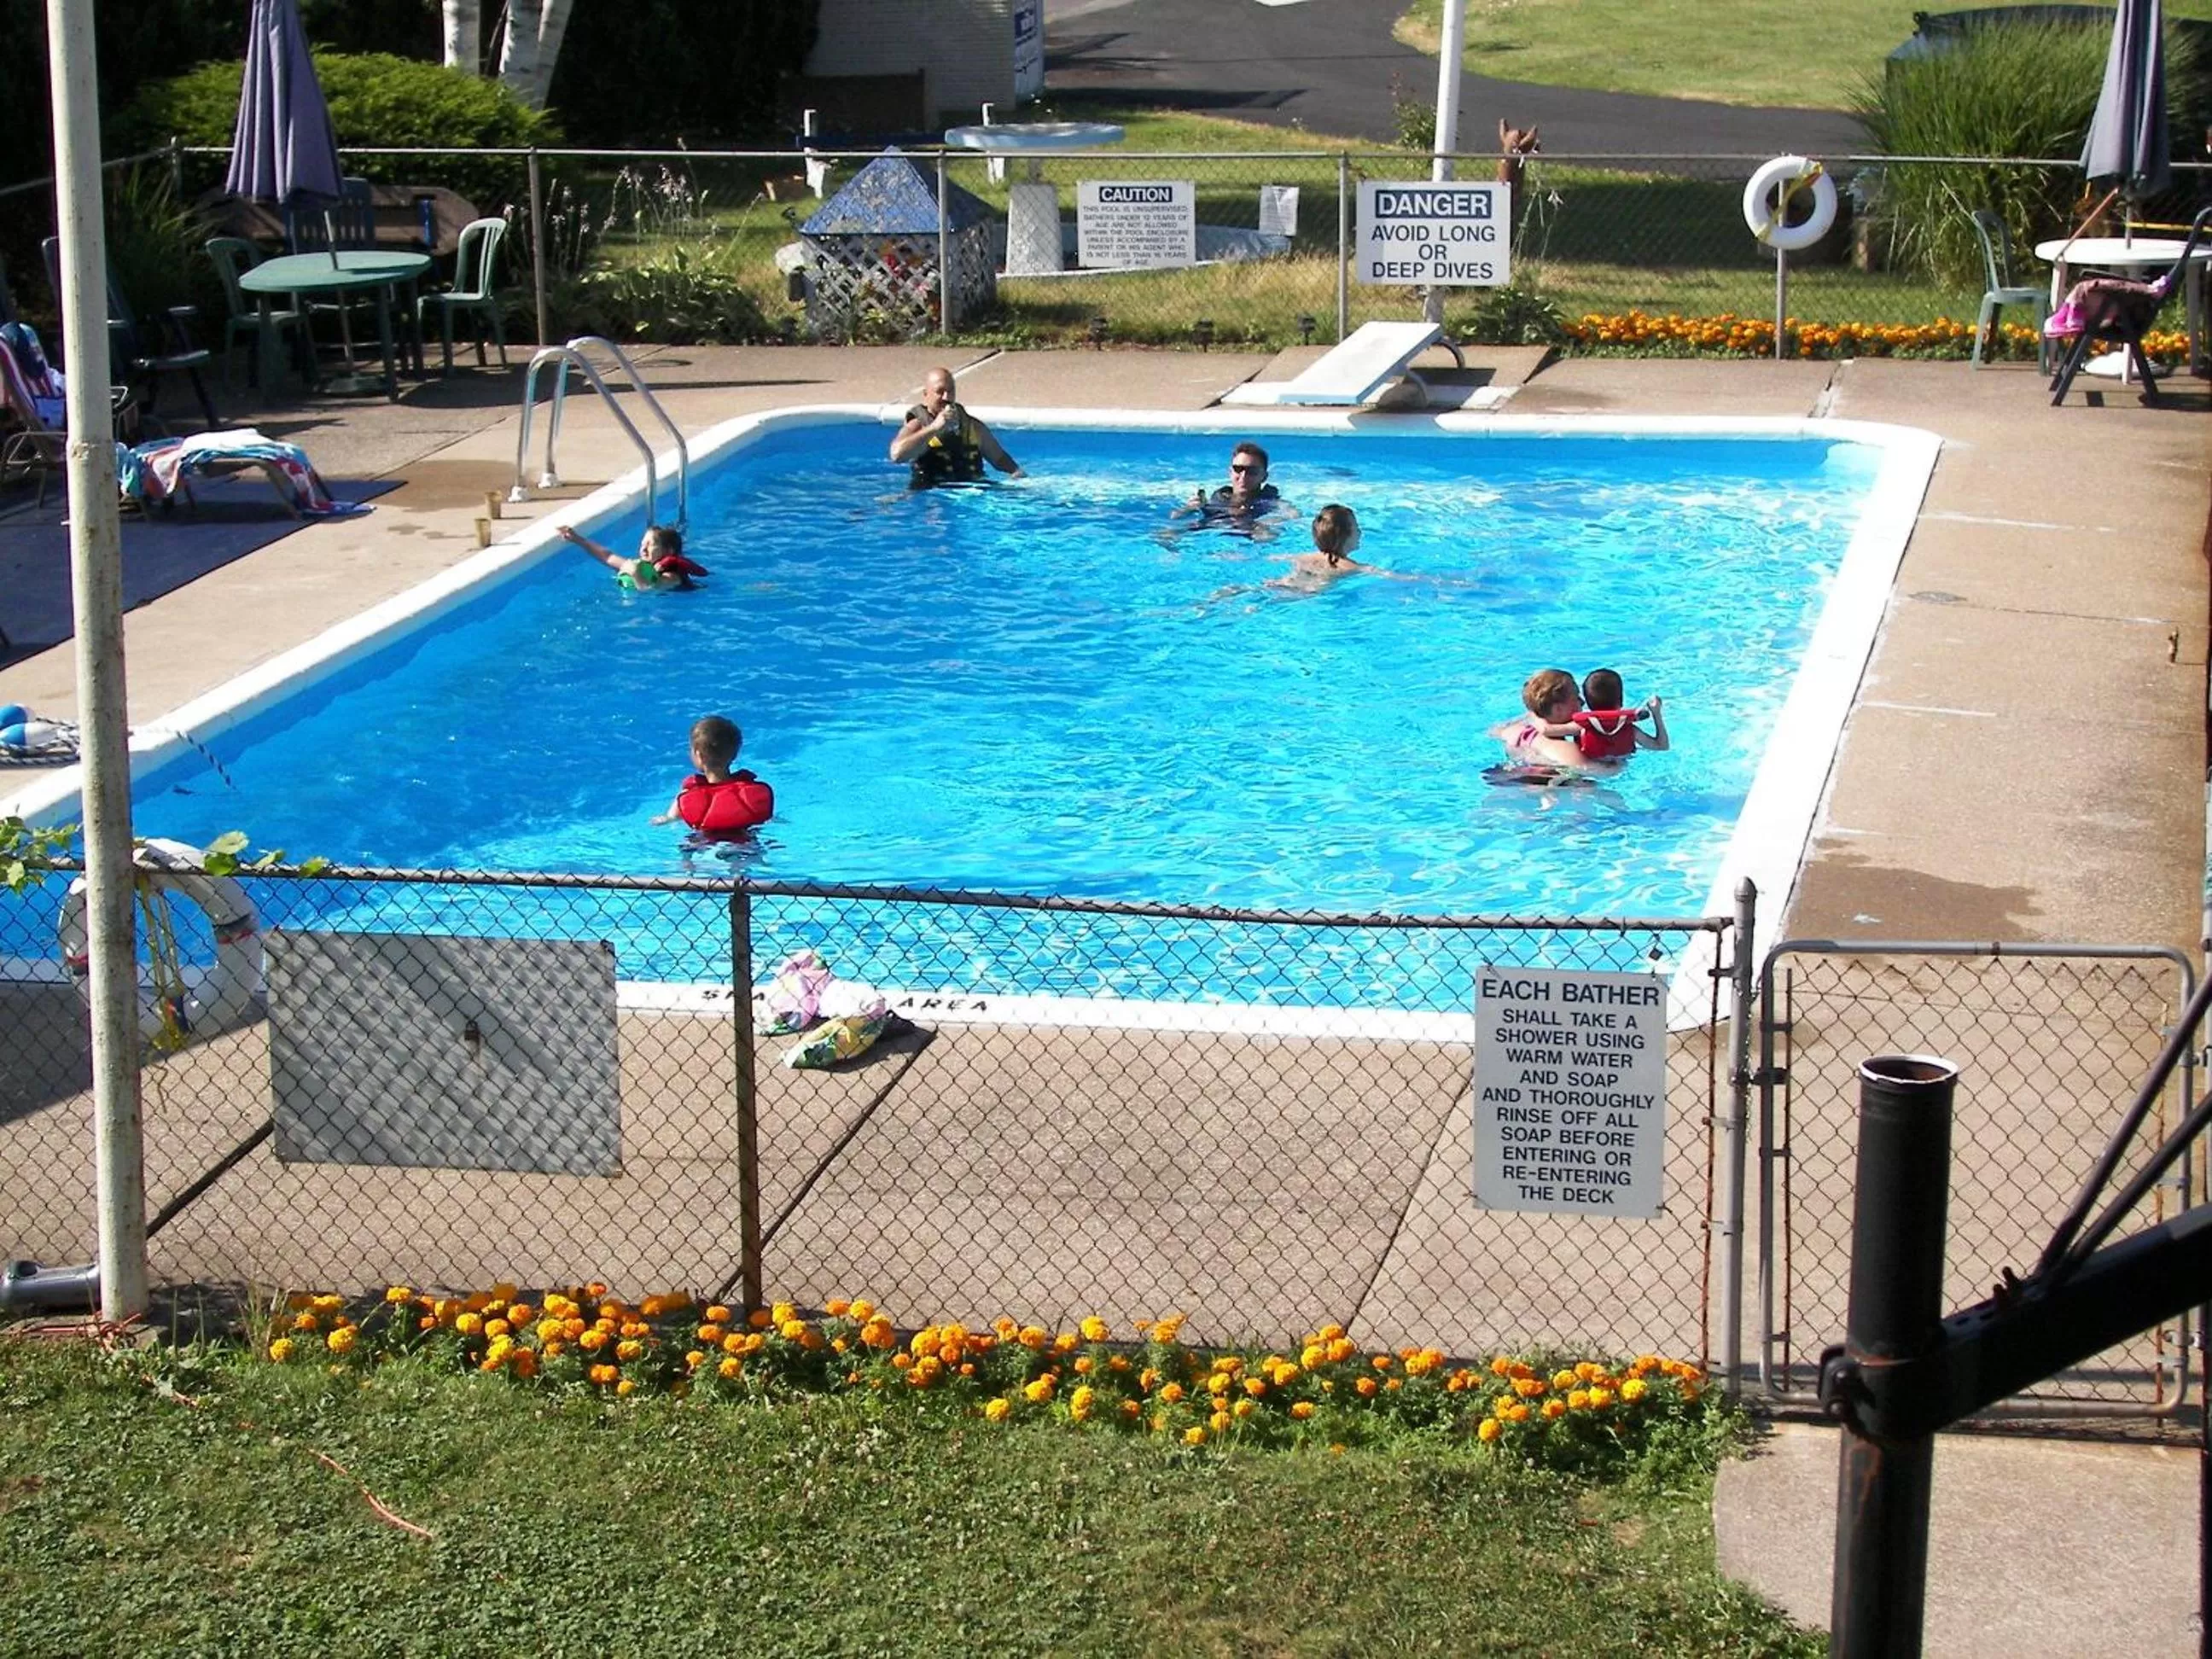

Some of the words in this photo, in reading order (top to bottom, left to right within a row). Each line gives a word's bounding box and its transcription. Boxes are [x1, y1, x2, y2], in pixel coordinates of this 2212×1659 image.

[1101, 188, 1171, 202] CAUTION
[1377, 193, 1488, 216] DANGER
[1371, 224, 1429, 242] AVOID
[1439, 225, 1496, 242] LONG
[1417, 243, 1448, 261] OR
[1371, 261, 1426, 278] DEEP
[1433, 262, 1493, 280] DIVES
[1481, 978, 1551, 1001] EACH
[1562, 982, 1660, 1007] BATHER
[897, 996, 988, 1012] AREA
[1502, 1007, 1563, 1026] SHALL
[1569, 1011, 1617, 1029] TAKE
[1624, 1015, 1639, 1030] A
[1494, 1027, 1578, 1046] SHOWER
[1586, 1031, 1645, 1050] USING
[1505, 1047, 1563, 1066] WARM
[1570, 1051, 1633, 1069] WATER
[1519, 1068, 1559, 1086] AND
[1566, 1071, 1619, 1088] SOAP
[1481, 1086, 1522, 1103] AND
[1528, 1088, 1655, 1109] THOROUGHLY
[1497, 1106, 1553, 1125] RINSE
[1560, 1109, 1598, 1126] OFF
[1604, 1112, 1639, 1129] ALL
[1500, 1125, 1552, 1144] SOAP
[1559, 1129, 1636, 1148] BEFORE
[1502, 1144, 1597, 1165] ENTERING
[1604, 1150, 1632, 1167] OR
[1502, 1164, 1632, 1186] RE-ENTERING
[1517, 1185, 1555, 1202] THE
[1562, 1187, 1615, 1204] DECK
